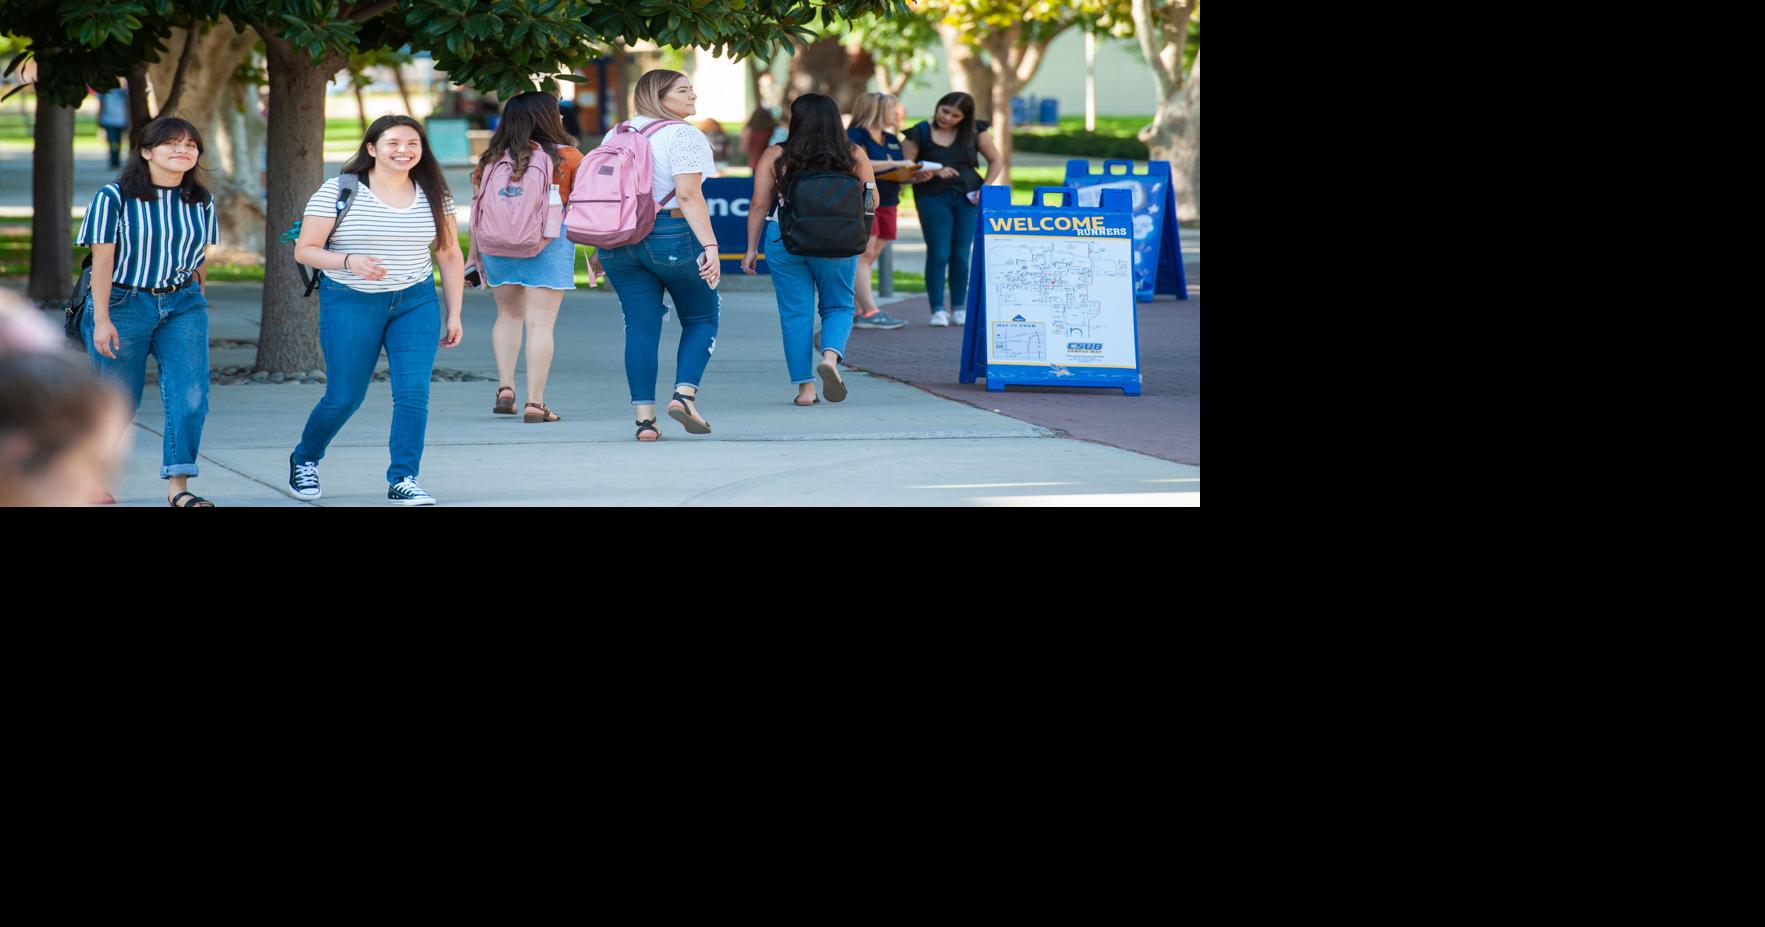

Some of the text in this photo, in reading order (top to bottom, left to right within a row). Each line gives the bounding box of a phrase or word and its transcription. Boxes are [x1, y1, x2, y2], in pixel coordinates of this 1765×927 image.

[989, 216, 1104, 231] WELCOME
[1076, 227, 1127, 236] RUNNERS
[1067, 342, 1104, 350] CSUB
